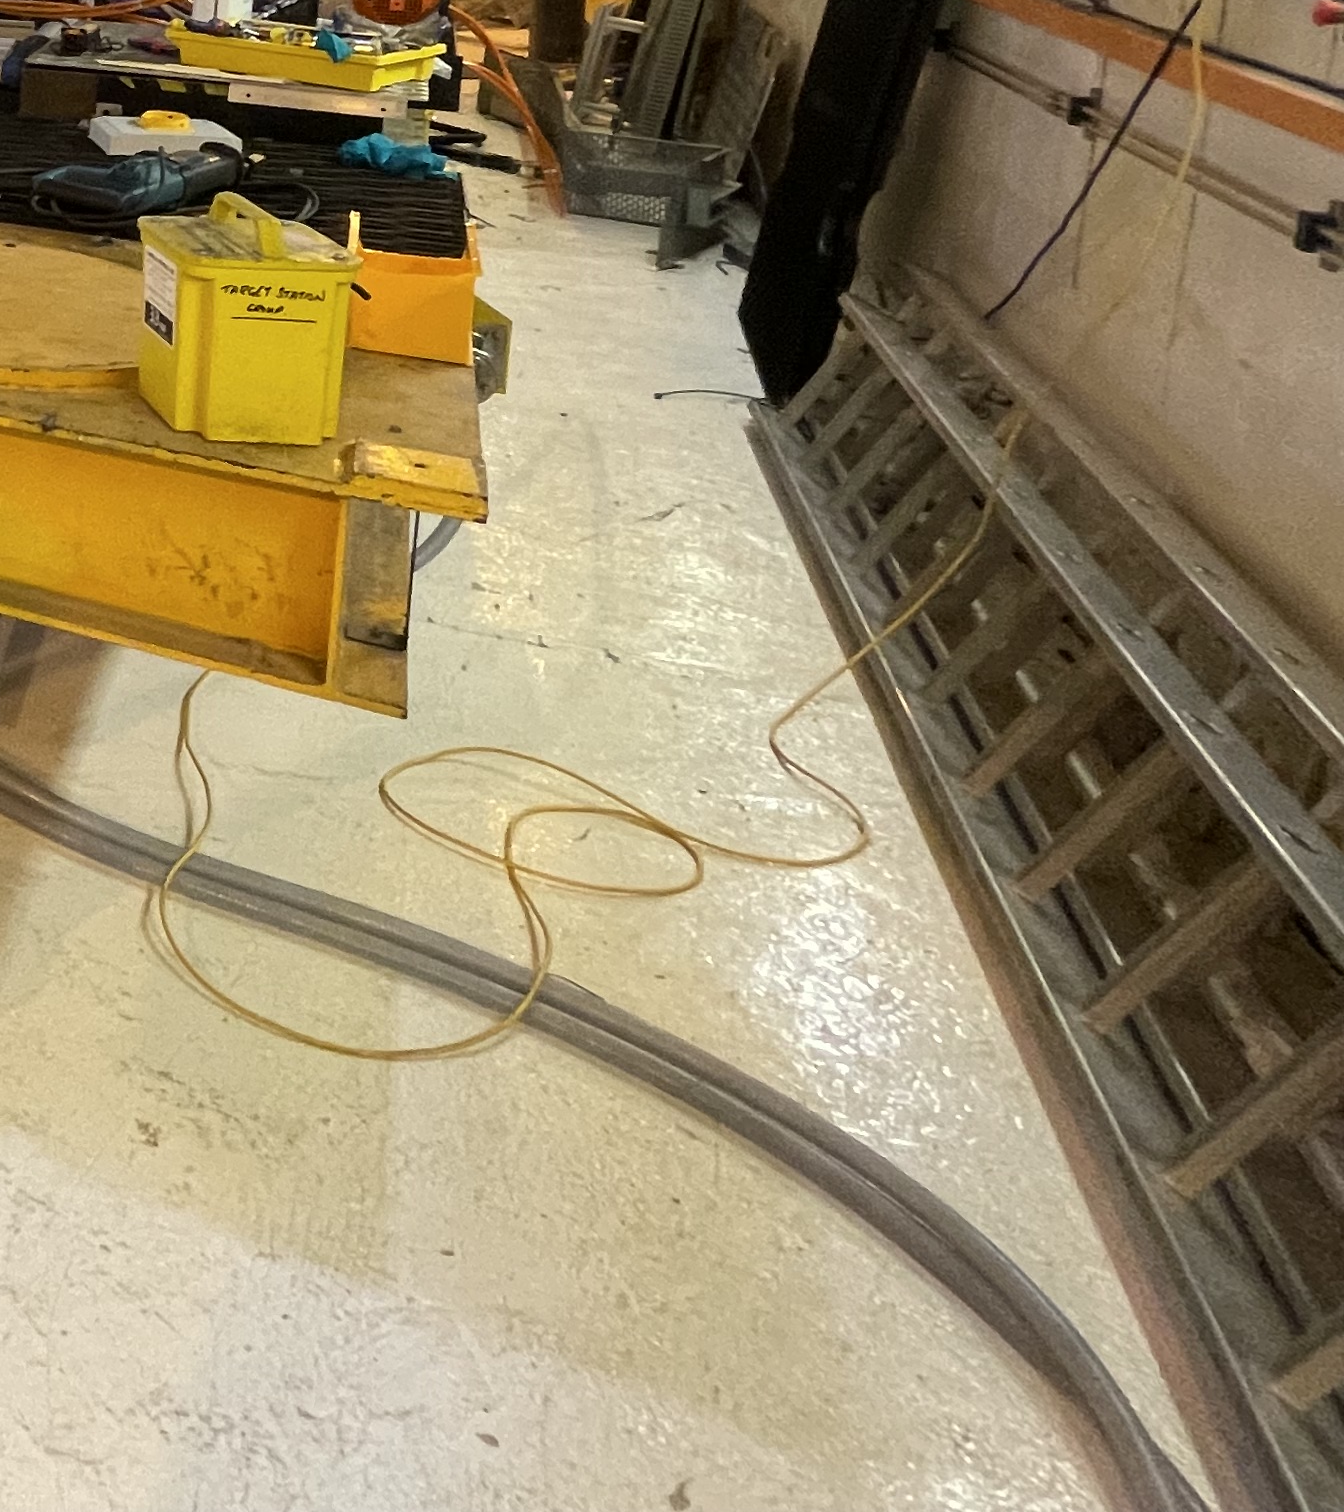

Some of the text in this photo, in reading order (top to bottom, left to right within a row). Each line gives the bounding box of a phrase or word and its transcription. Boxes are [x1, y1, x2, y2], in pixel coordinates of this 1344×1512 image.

[220, 284, 326, 301] TARGET STATION
[246, 303, 284, 314] GROUP
